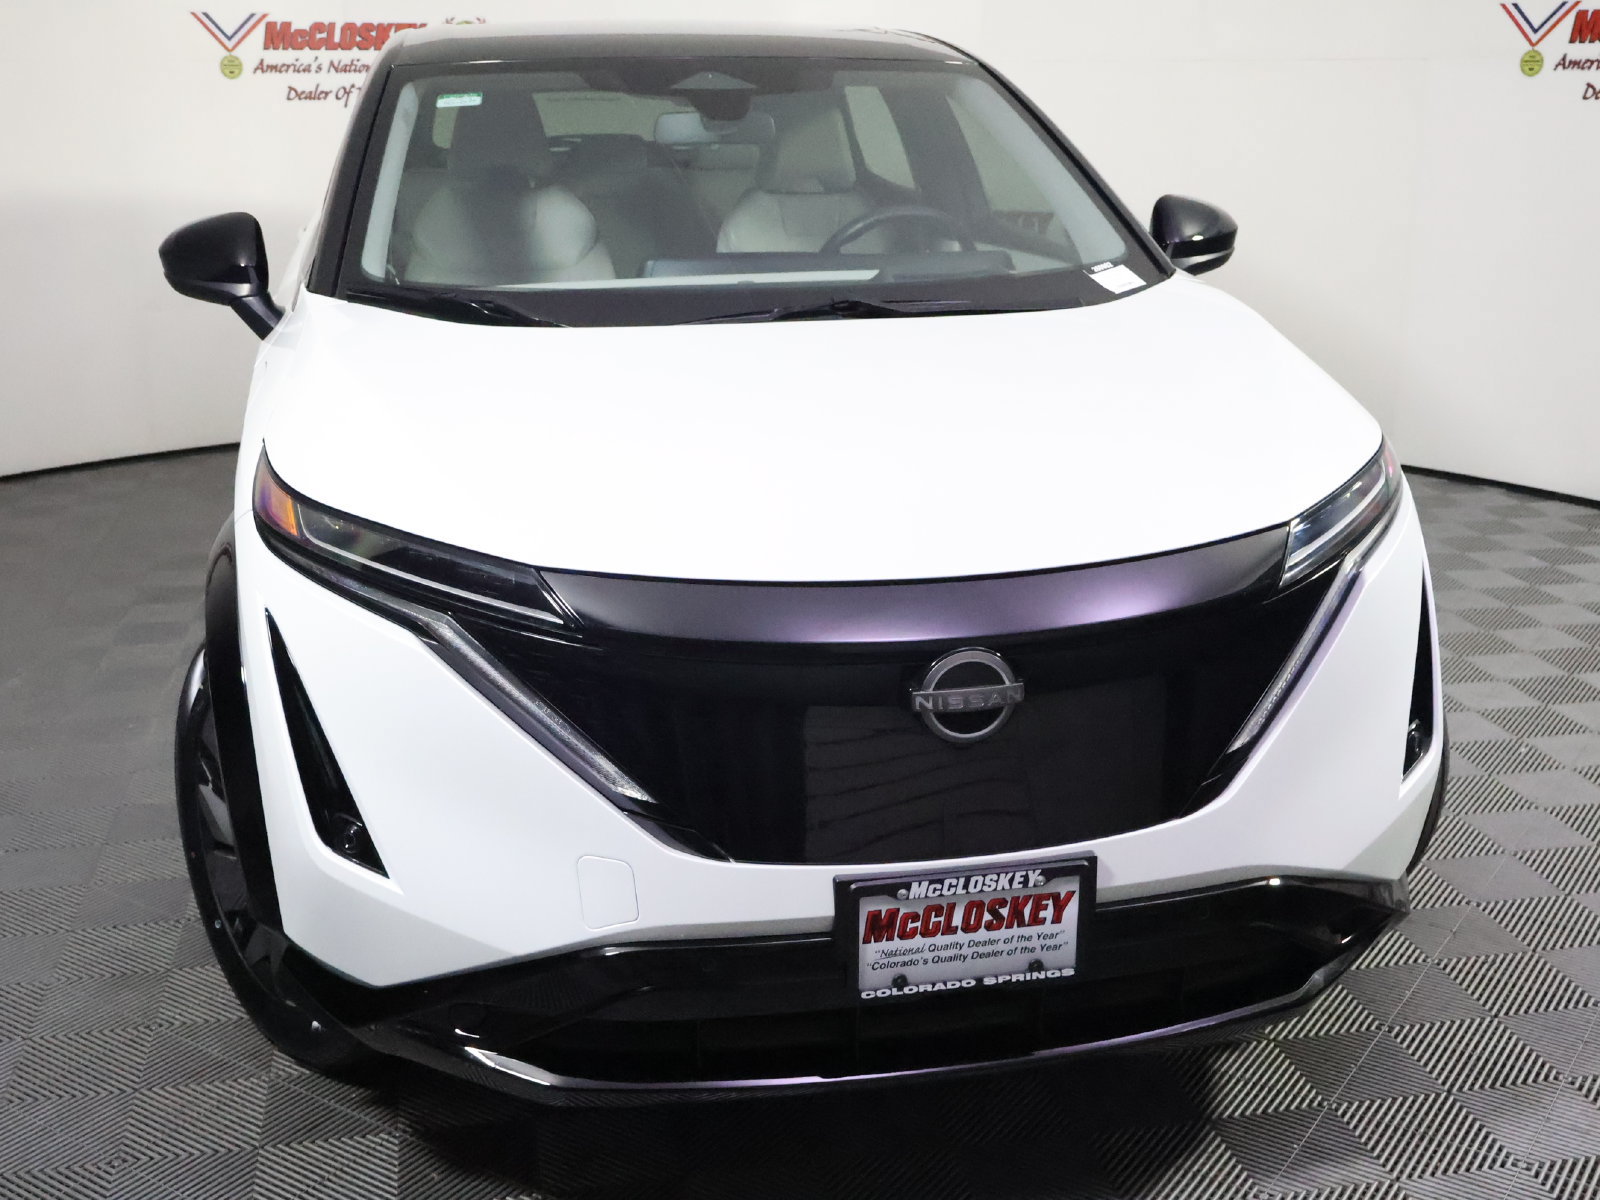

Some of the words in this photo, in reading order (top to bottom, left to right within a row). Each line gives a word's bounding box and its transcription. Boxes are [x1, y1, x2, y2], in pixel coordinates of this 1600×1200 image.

[263, 22, 428, 50] McCLOSK
[253, 56, 322, 74] America's
[286, 84, 332, 101] Dealer
[335, 84, 354, 108] Of
[914, 686, 1022, 710] NISSAN
[909, 869, 1041, 900] McCLOSKEY
[862, 891, 1076, 944] McCLOSKEY
[928, 940, 965, 953] Quality
[967, 937, 1000, 949] Dealer
[1003, 934, 1015, 945] of
[1017, 932, 1033, 943] the
[931, 952, 969, 963] Quality
[971, 948, 1004, 960] Dealer
[1006, 945, 1018, 957] of
[1020, 944, 1036, 955] the
[860, 978, 976, 1000] COLORADO
[983, 967, 1076, 986] SPRINGS
